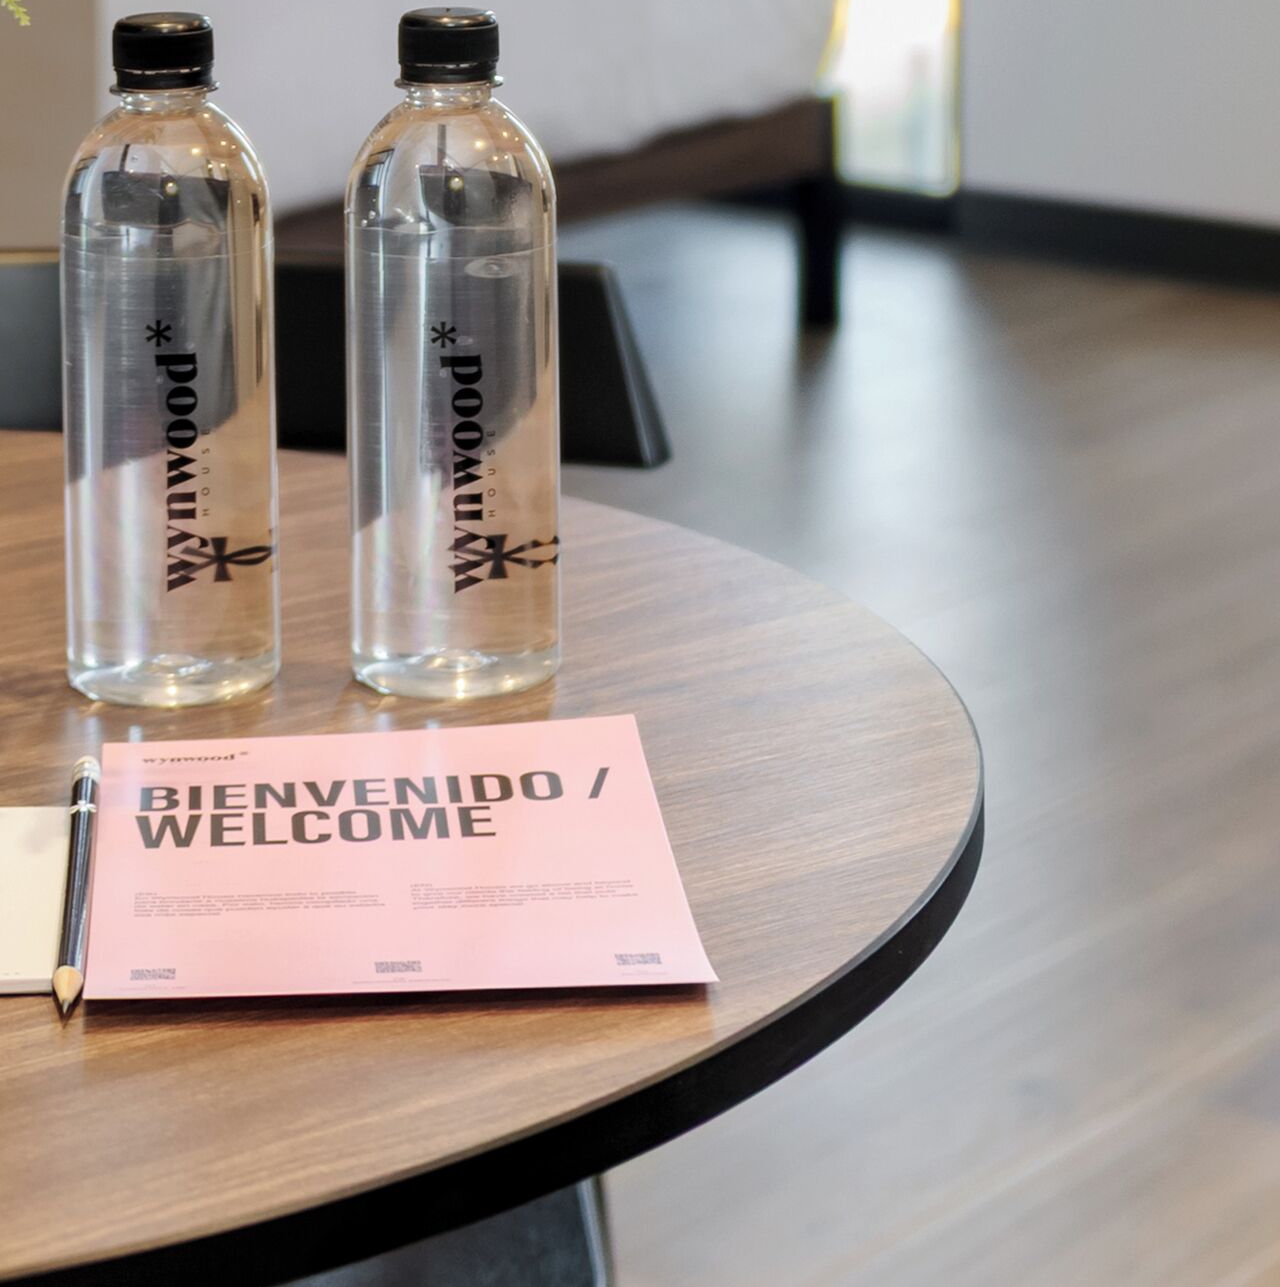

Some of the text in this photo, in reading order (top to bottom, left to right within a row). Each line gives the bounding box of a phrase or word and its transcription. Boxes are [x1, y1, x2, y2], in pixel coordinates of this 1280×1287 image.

[154, 352, 209, 593] wynwood
[440, 353, 495, 594] wynwood
[135, 806, 497, 849] WELCOME
[139, 770, 564, 812] BIENVENIDO
